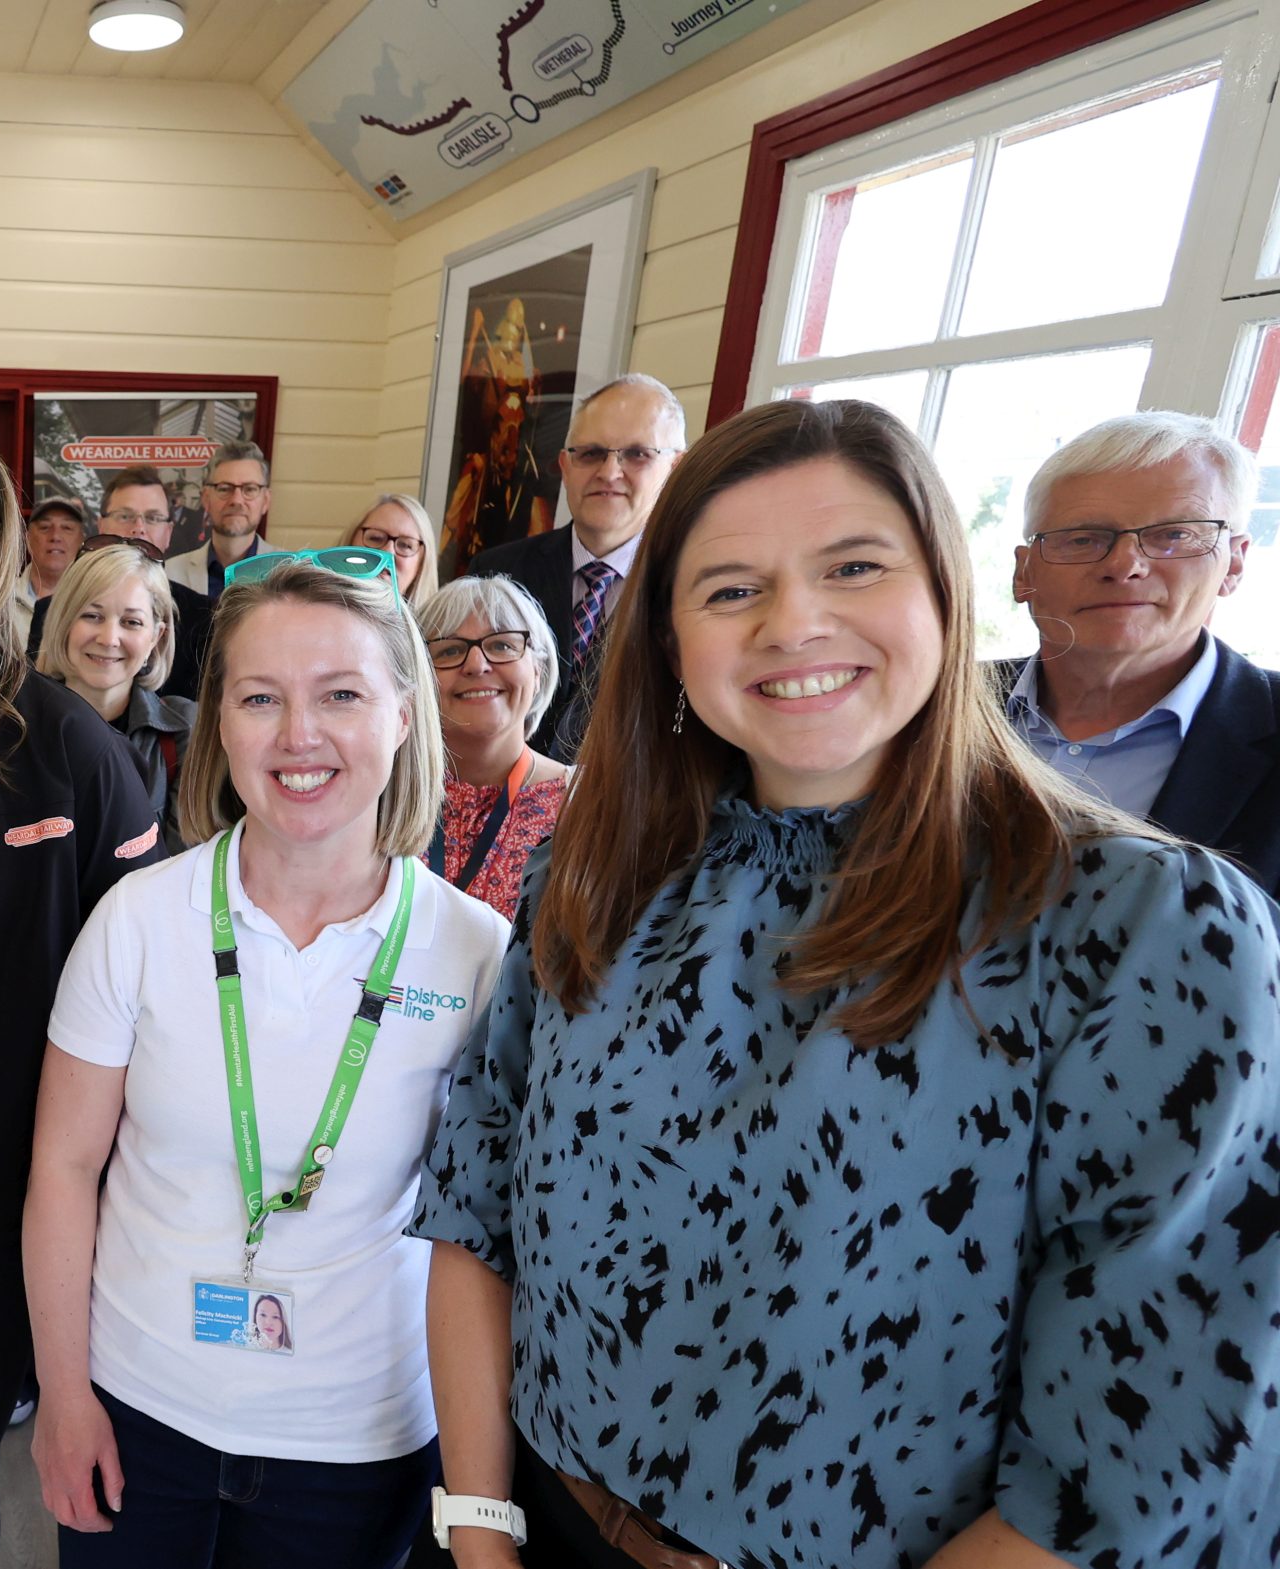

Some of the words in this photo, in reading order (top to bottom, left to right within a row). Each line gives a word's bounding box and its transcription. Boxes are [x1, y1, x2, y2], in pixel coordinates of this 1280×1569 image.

[671, 0, 724, 37] Journey
[538, 41, 587, 75] WETHERAL
[447, 120, 502, 160] CARLISLE
[69, 446, 152, 459] WEARDALE
[155, 446, 217, 459] RAILWAY
[403, 1001, 435, 1021] line
[406, 986, 466, 1012] bishop
[228, 1004, 244, 1087] #MentalHealthFirstAid
[240, 1110, 255, 1172] mhfaengland.org
